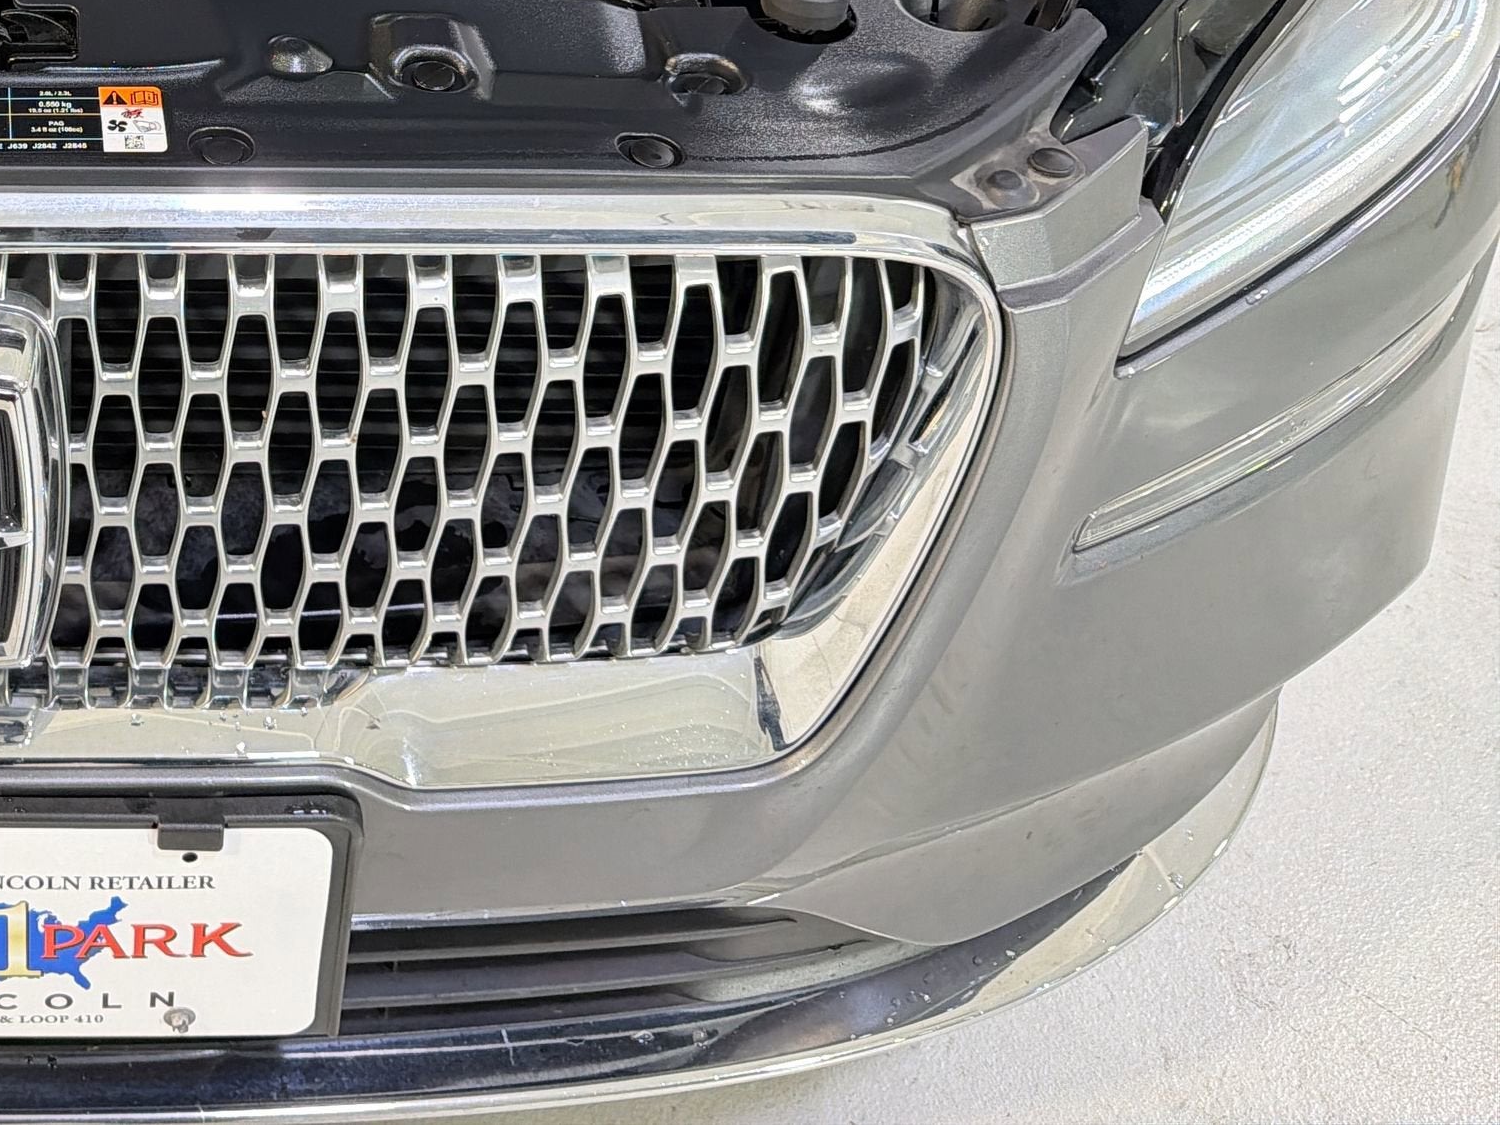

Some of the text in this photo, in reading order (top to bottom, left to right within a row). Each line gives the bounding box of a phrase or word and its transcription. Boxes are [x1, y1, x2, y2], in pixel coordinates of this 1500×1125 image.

[89, 875, 216, 890] RETAILER
[40, 922, 253, 959] PARK
[0, 1014, 13, 1024] &
[19, 1014, 69, 1024] LOOP
[73, 1014, 104, 1024] 410
